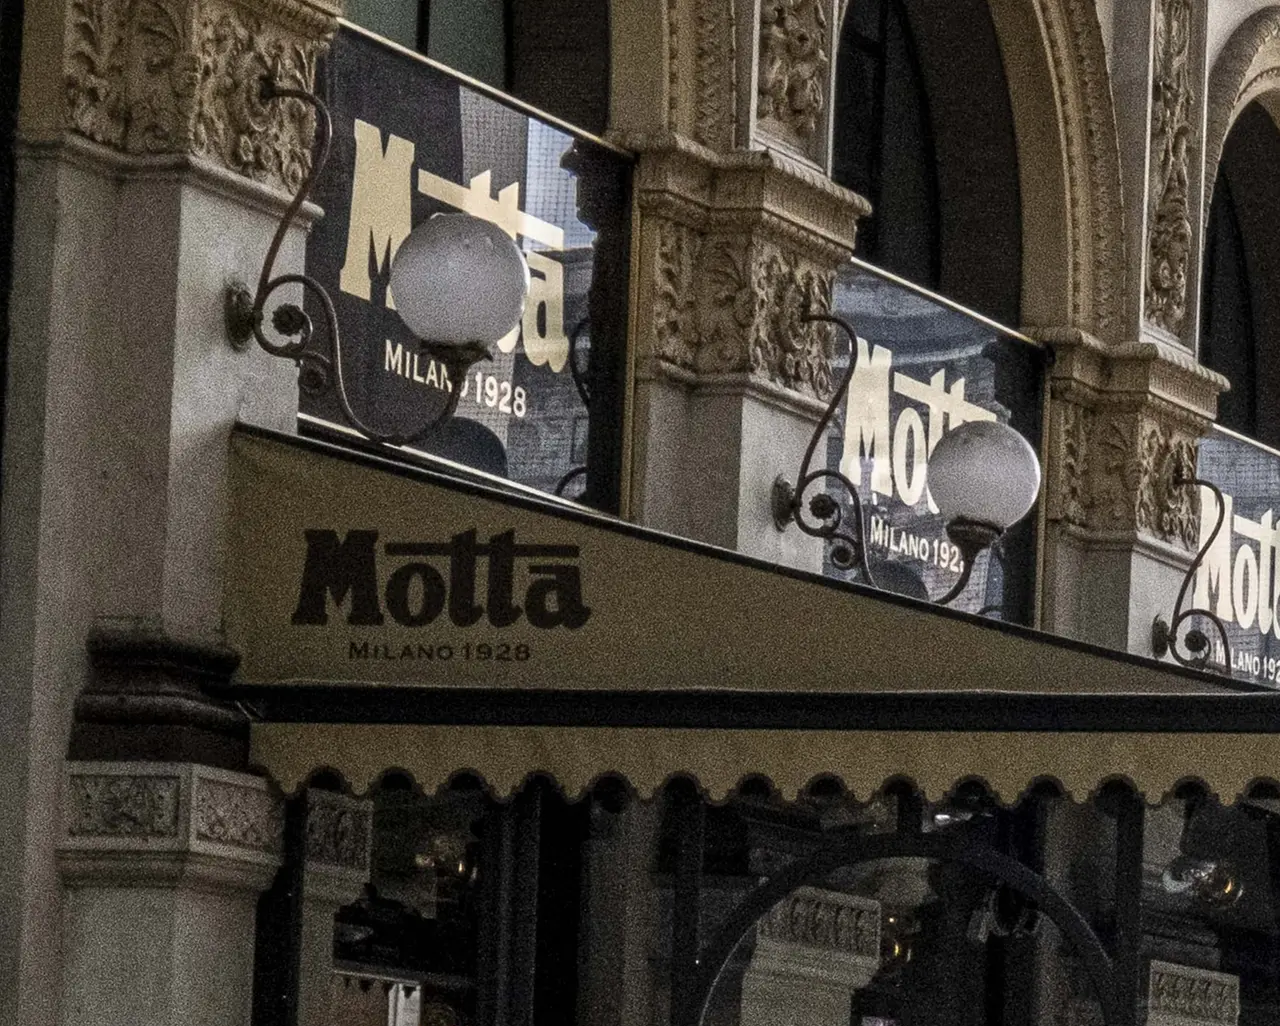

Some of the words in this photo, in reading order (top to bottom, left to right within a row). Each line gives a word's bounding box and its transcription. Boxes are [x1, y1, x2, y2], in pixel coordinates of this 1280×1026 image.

[339, 117, 570, 373] Mta
[384, 338, 468, 398] MILAN
[475, 371, 527, 418] 1928
[839, 336, 998, 514] Mot
[290, 527, 592, 630] Motta
[870, 515, 930, 564] MILANO
[932, 540, 964, 574] 192
[348, 641, 454, 661] MILANO
[463, 643, 531, 662] 1928
[1216, 640, 1261, 677] MLANO
